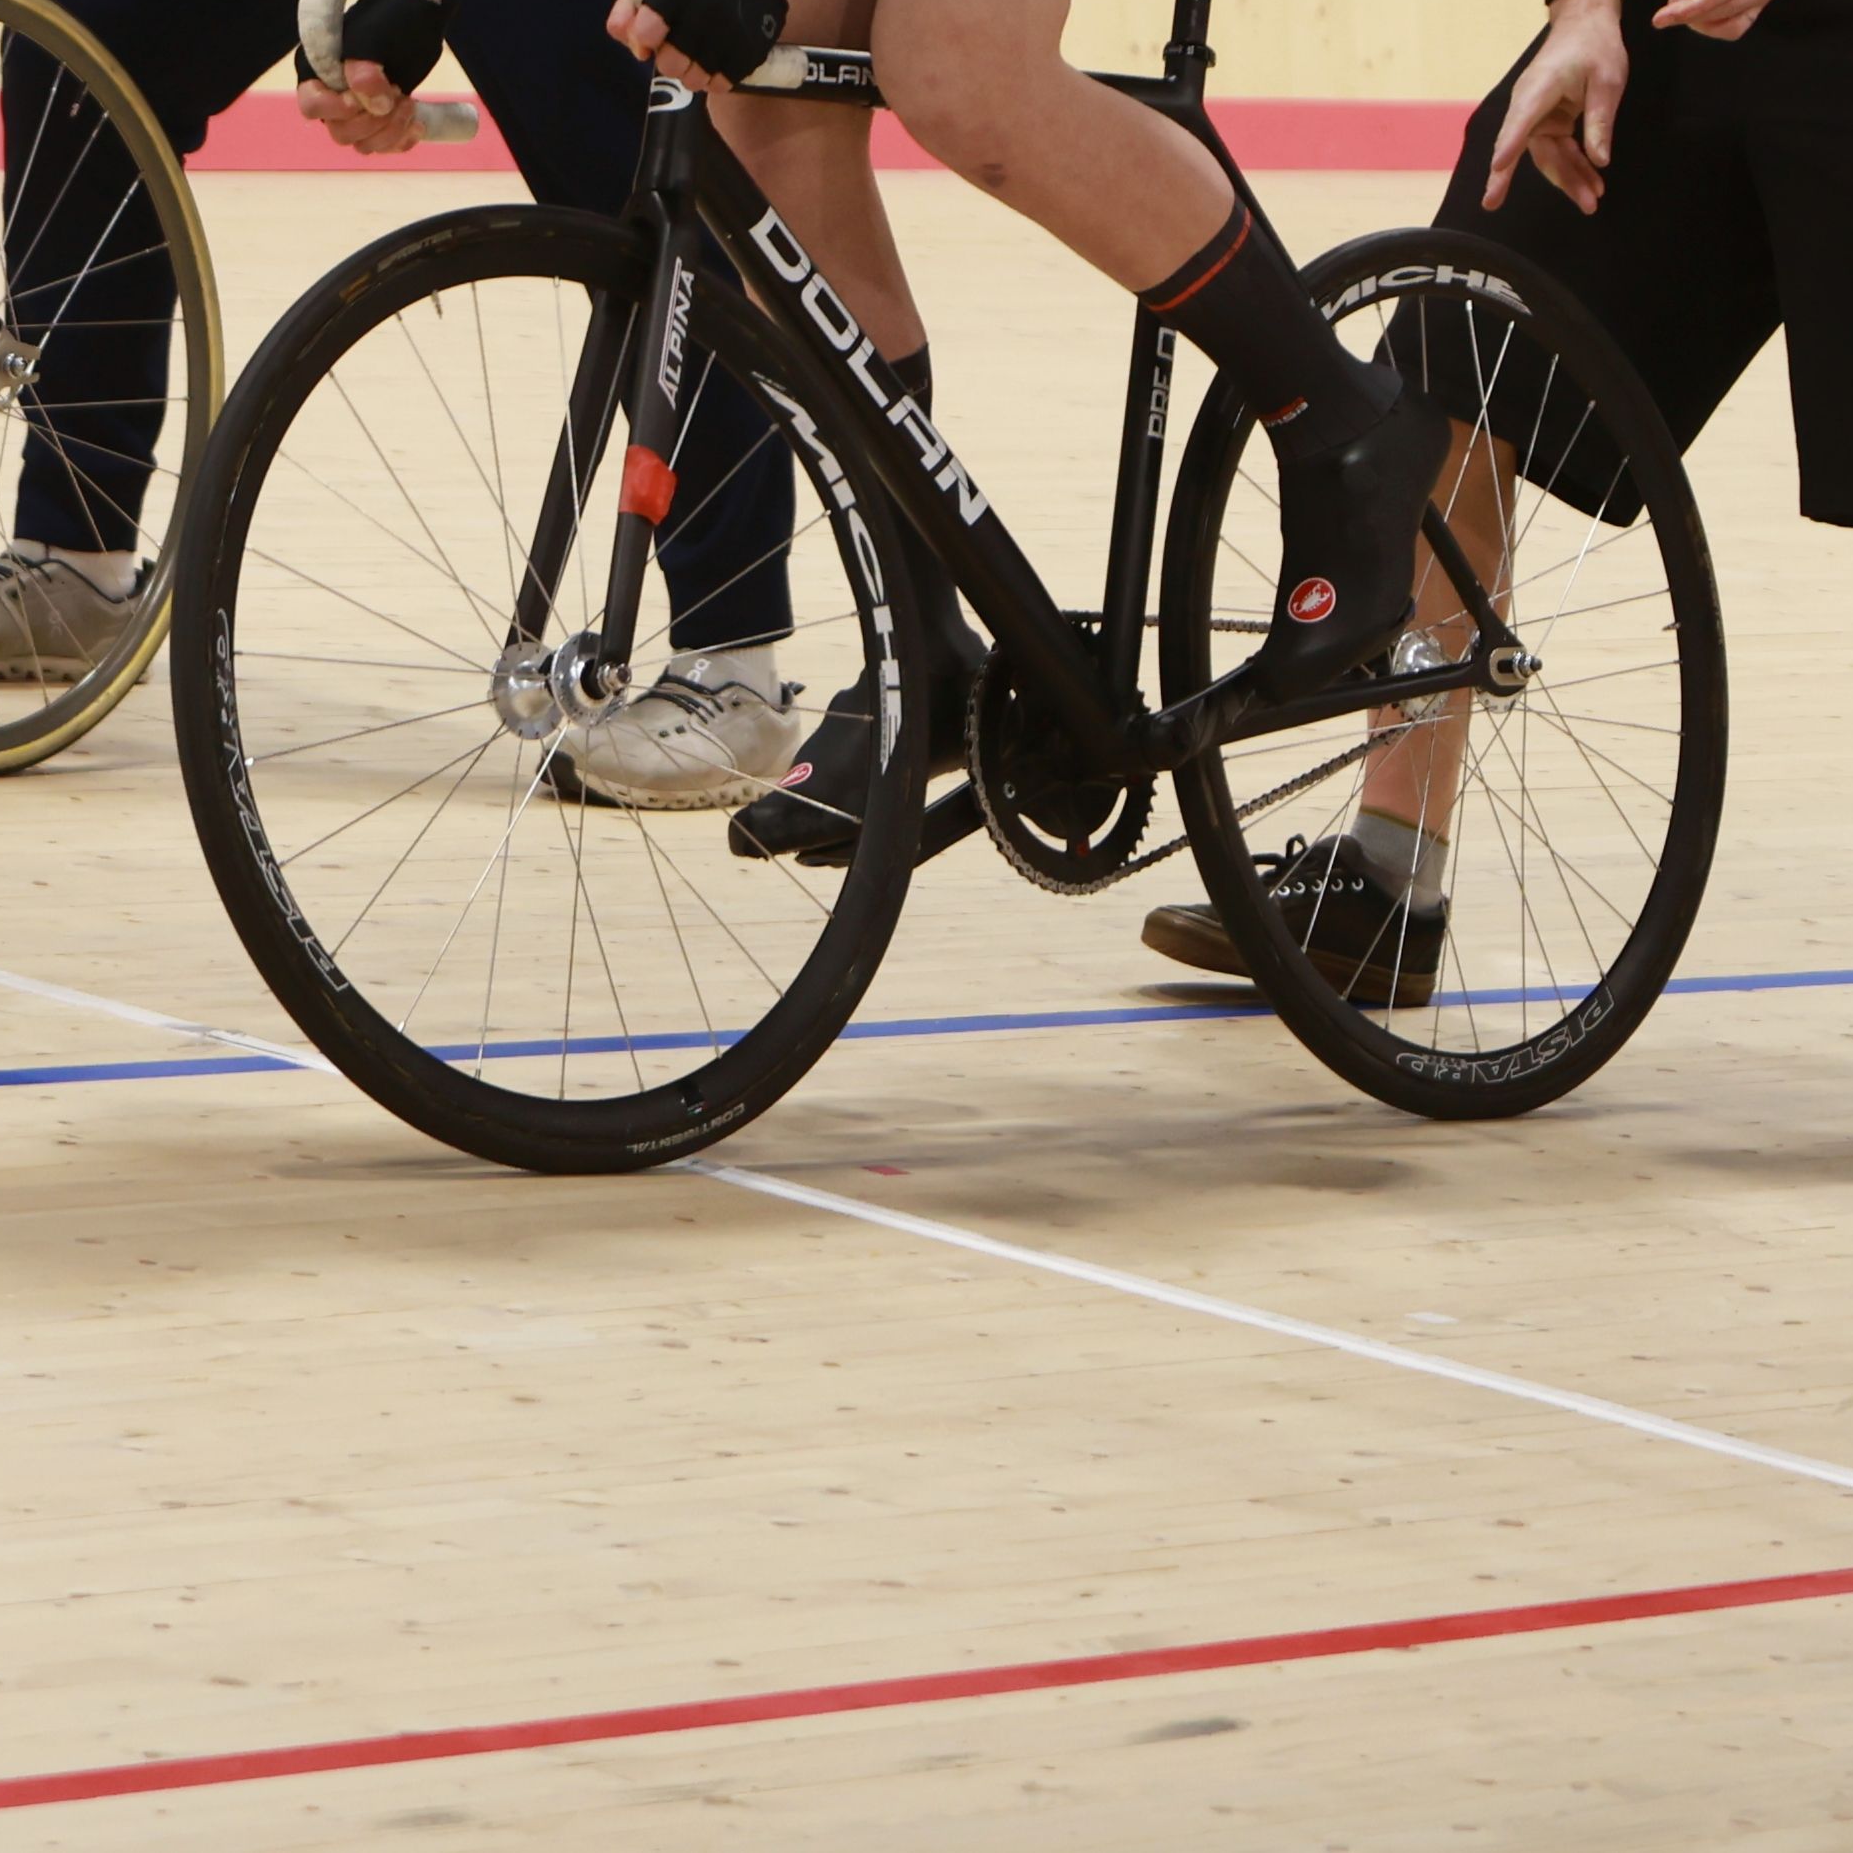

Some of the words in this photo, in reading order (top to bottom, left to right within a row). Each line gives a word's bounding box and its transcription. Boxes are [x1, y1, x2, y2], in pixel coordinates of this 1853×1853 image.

[657, 268, 696, 412] ALPINA
[748, 205, 990, 527] DOLAN
[757, 379, 903, 777] MICHE
